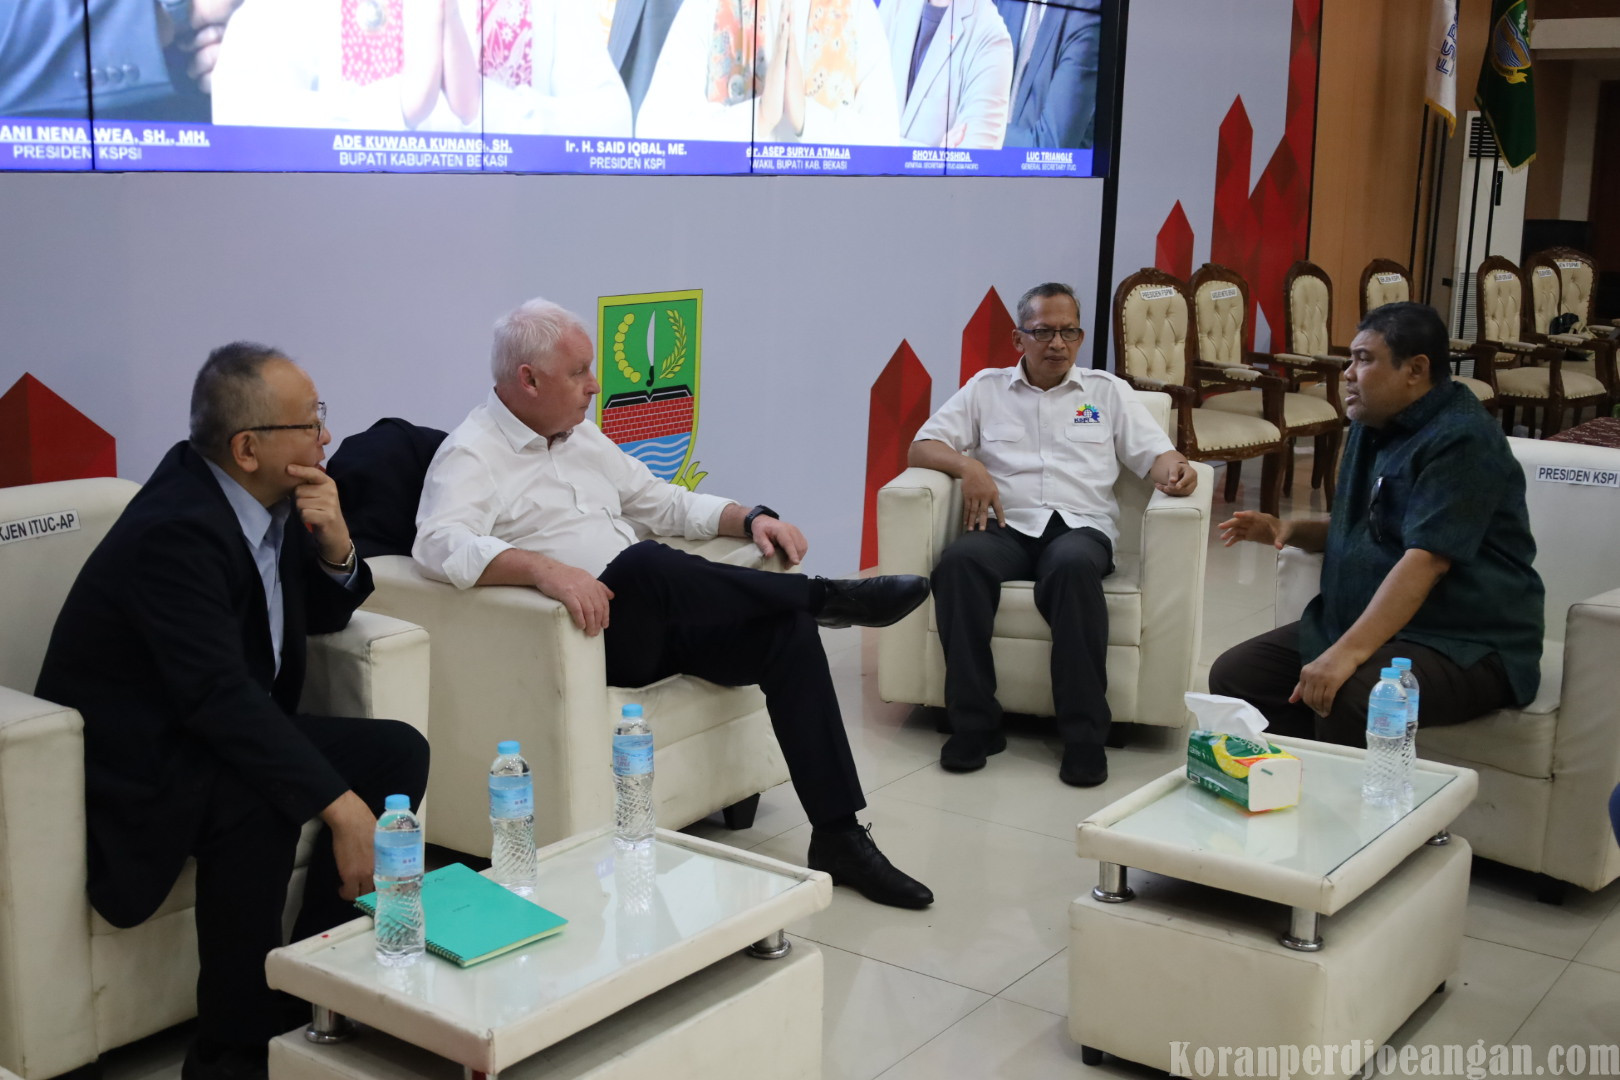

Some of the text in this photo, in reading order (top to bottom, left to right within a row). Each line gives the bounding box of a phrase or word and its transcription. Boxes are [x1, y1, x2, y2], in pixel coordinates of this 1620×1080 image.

[0, 125, 32, 141] ANI
[37, 126, 87, 142] NENA
[94, 127, 139, 144] WEA,
[179, 130, 210, 146] MH.
[334, 135, 361, 149] ADE
[365, 136, 427, 150] KUWARA
[492, 139, 512, 152] SH.
[13, 144, 142, 160] PRESIDEN KSPSI
[565, 140, 687, 156] Ir. H. SAID IQBAL, ME.
[762, 146, 785, 157] ASEP
[787, 147, 814, 158] SURYA
[815, 147, 850, 158] ATMAJA
[912, 150, 971, 162] SHOYA YOSHIDA
[339, 152, 508, 168] BUPATI KABUPATEN BEKASI
[590, 157, 666, 170] PRESIDEN KSPI
[750, 159, 847, 170] WAKIL BUPATI KAB. BEKASI
[1026, 151, 1073, 162] LUC TRIANGLE
[1021, 163, 1041, 171] GENERAL
[1042, 163, 1066, 171] SECRETARY
[1538, 467, 1618, 485] PRESIDEN KSPI
[28, 513, 74, 535] ITUC-AP
